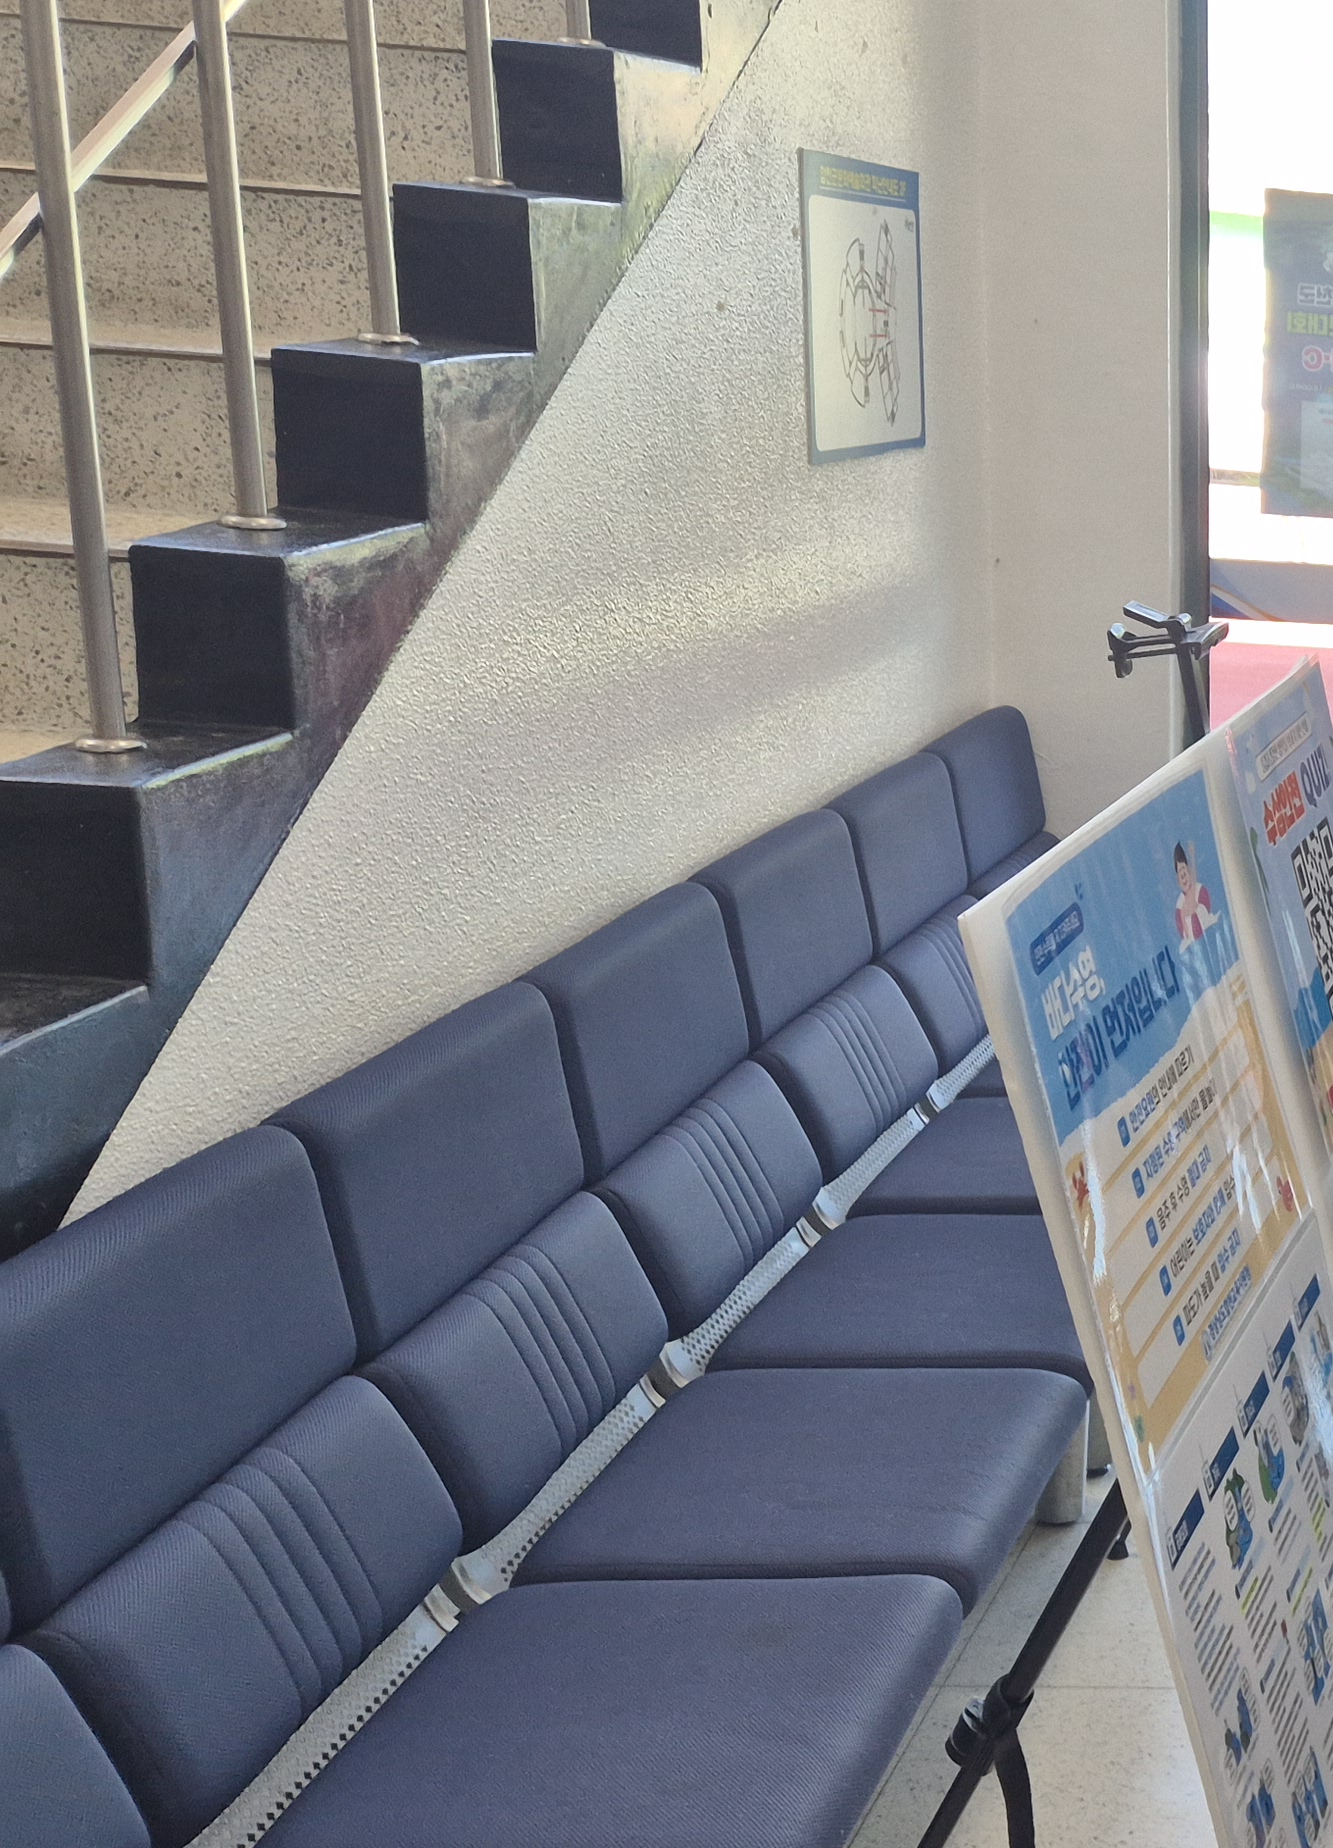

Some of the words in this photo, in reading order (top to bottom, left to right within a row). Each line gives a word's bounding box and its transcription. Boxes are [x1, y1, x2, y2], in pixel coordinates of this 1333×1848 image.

[1263, 770, 1306, 846] 수상안전
[1042, 945, 1106, 1041] 바다수영,
[1058, 1015, 1109, 1111] 안전이
[1102, 945, 1180, 1060] 먼저입니다
[1129, 1084, 1161, 1133] 안전요원의
[1158, 1065, 1178, 1098] 안내에
[1174, 1044, 1195, 1078] 따르기
[1143, 1145, 1165, 1179] 지정된
[1156, 1199, 1171, 1231] 음주
[1176, 1175, 1190, 1204] 수영
[1198, 1144, 1212, 1173] 금지
[1170, 1236, 1196, 1278] 어린이는
[1192, 1204, 1217, 1247] 보호자와
[1183, 1282, 1202, 1326] 파도가
[1200, 1270, 1215, 1301] 높을
[1216, 1247, 1230, 1275] 입수
[1226, 1227, 1241, 1258] 금지
